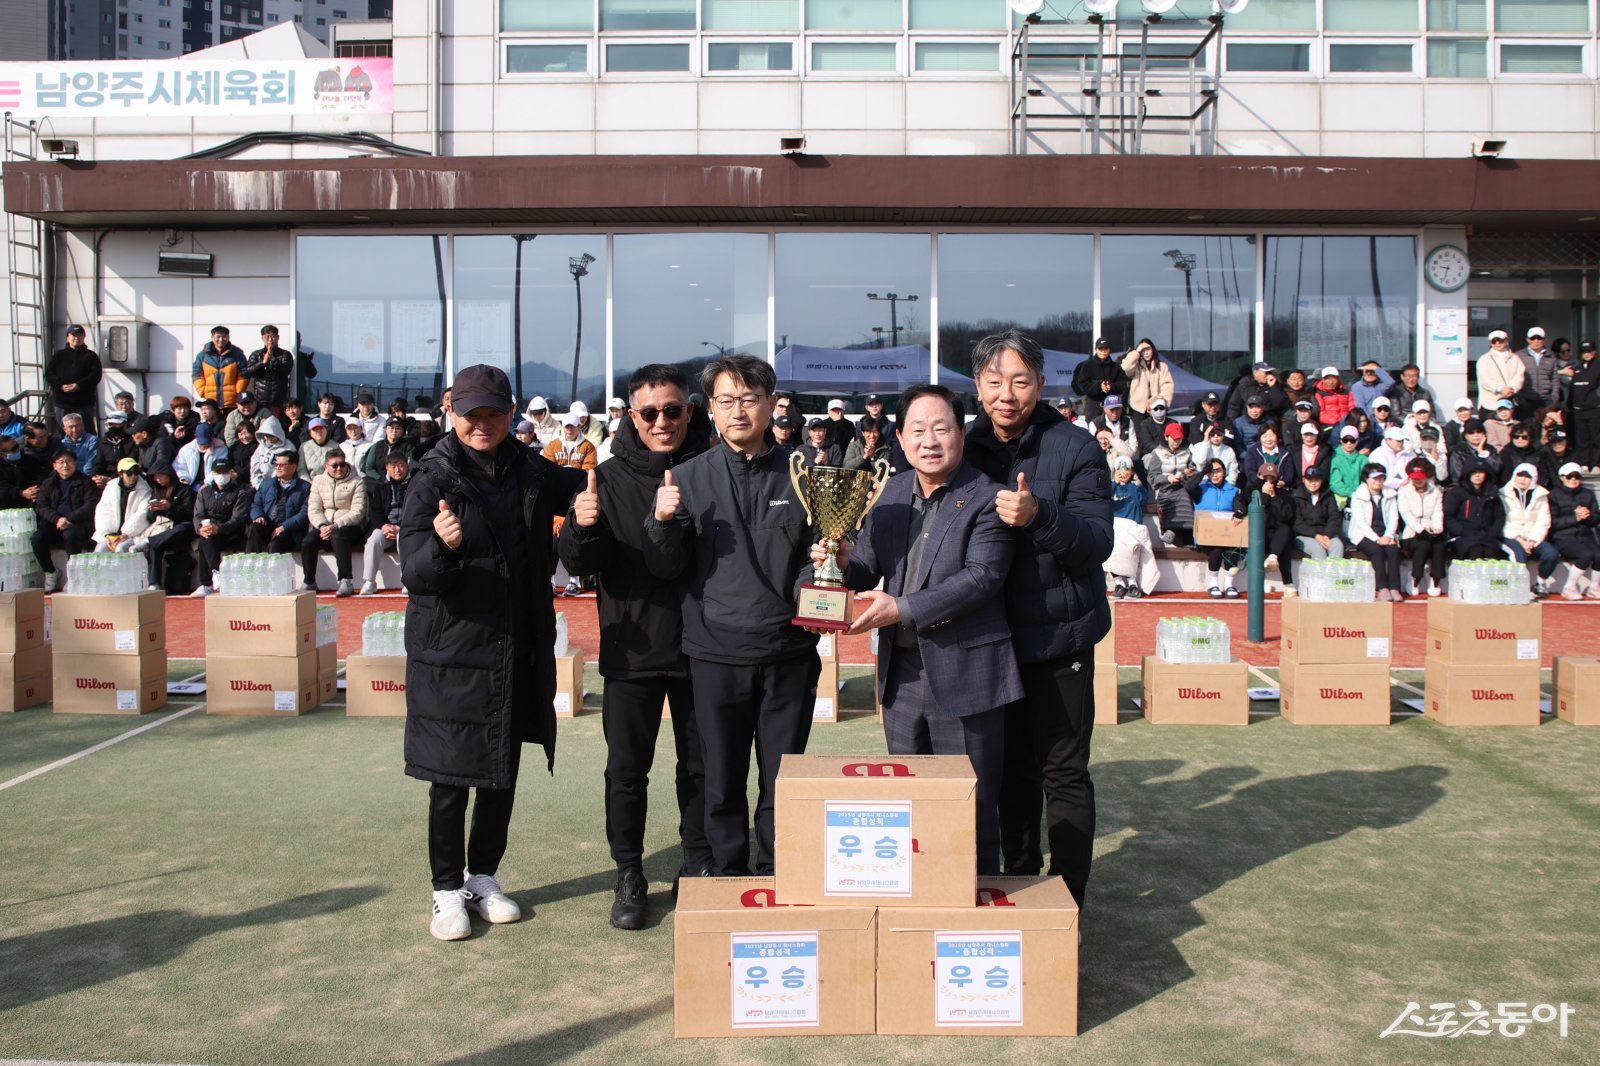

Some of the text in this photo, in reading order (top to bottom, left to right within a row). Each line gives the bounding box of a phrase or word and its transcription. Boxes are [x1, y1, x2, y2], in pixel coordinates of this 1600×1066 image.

[35, 69, 296, 107] 남양주시체육회
[74, 618, 114, 630] Wilson
[228, 620, 271, 631] Wilson
[1322, 627, 1366, 639] Wilson
[1474, 629, 1516, 640] Wilson
[75, 678, 116, 690] Wilson
[230, 680, 272, 691] Wilson
[371, 680, 406, 692] Wilso
[1178, 688, 1221, 699] Wilson
[1320, 688, 1363, 700] Wilson
[1472, 689, 1514, 701] Wilson
[838, 835, 862, 857] 우
[874, 836, 898, 858] 승
[745, 966, 805, 988] 우 승
[949, 965, 1009, 988] 우 승
